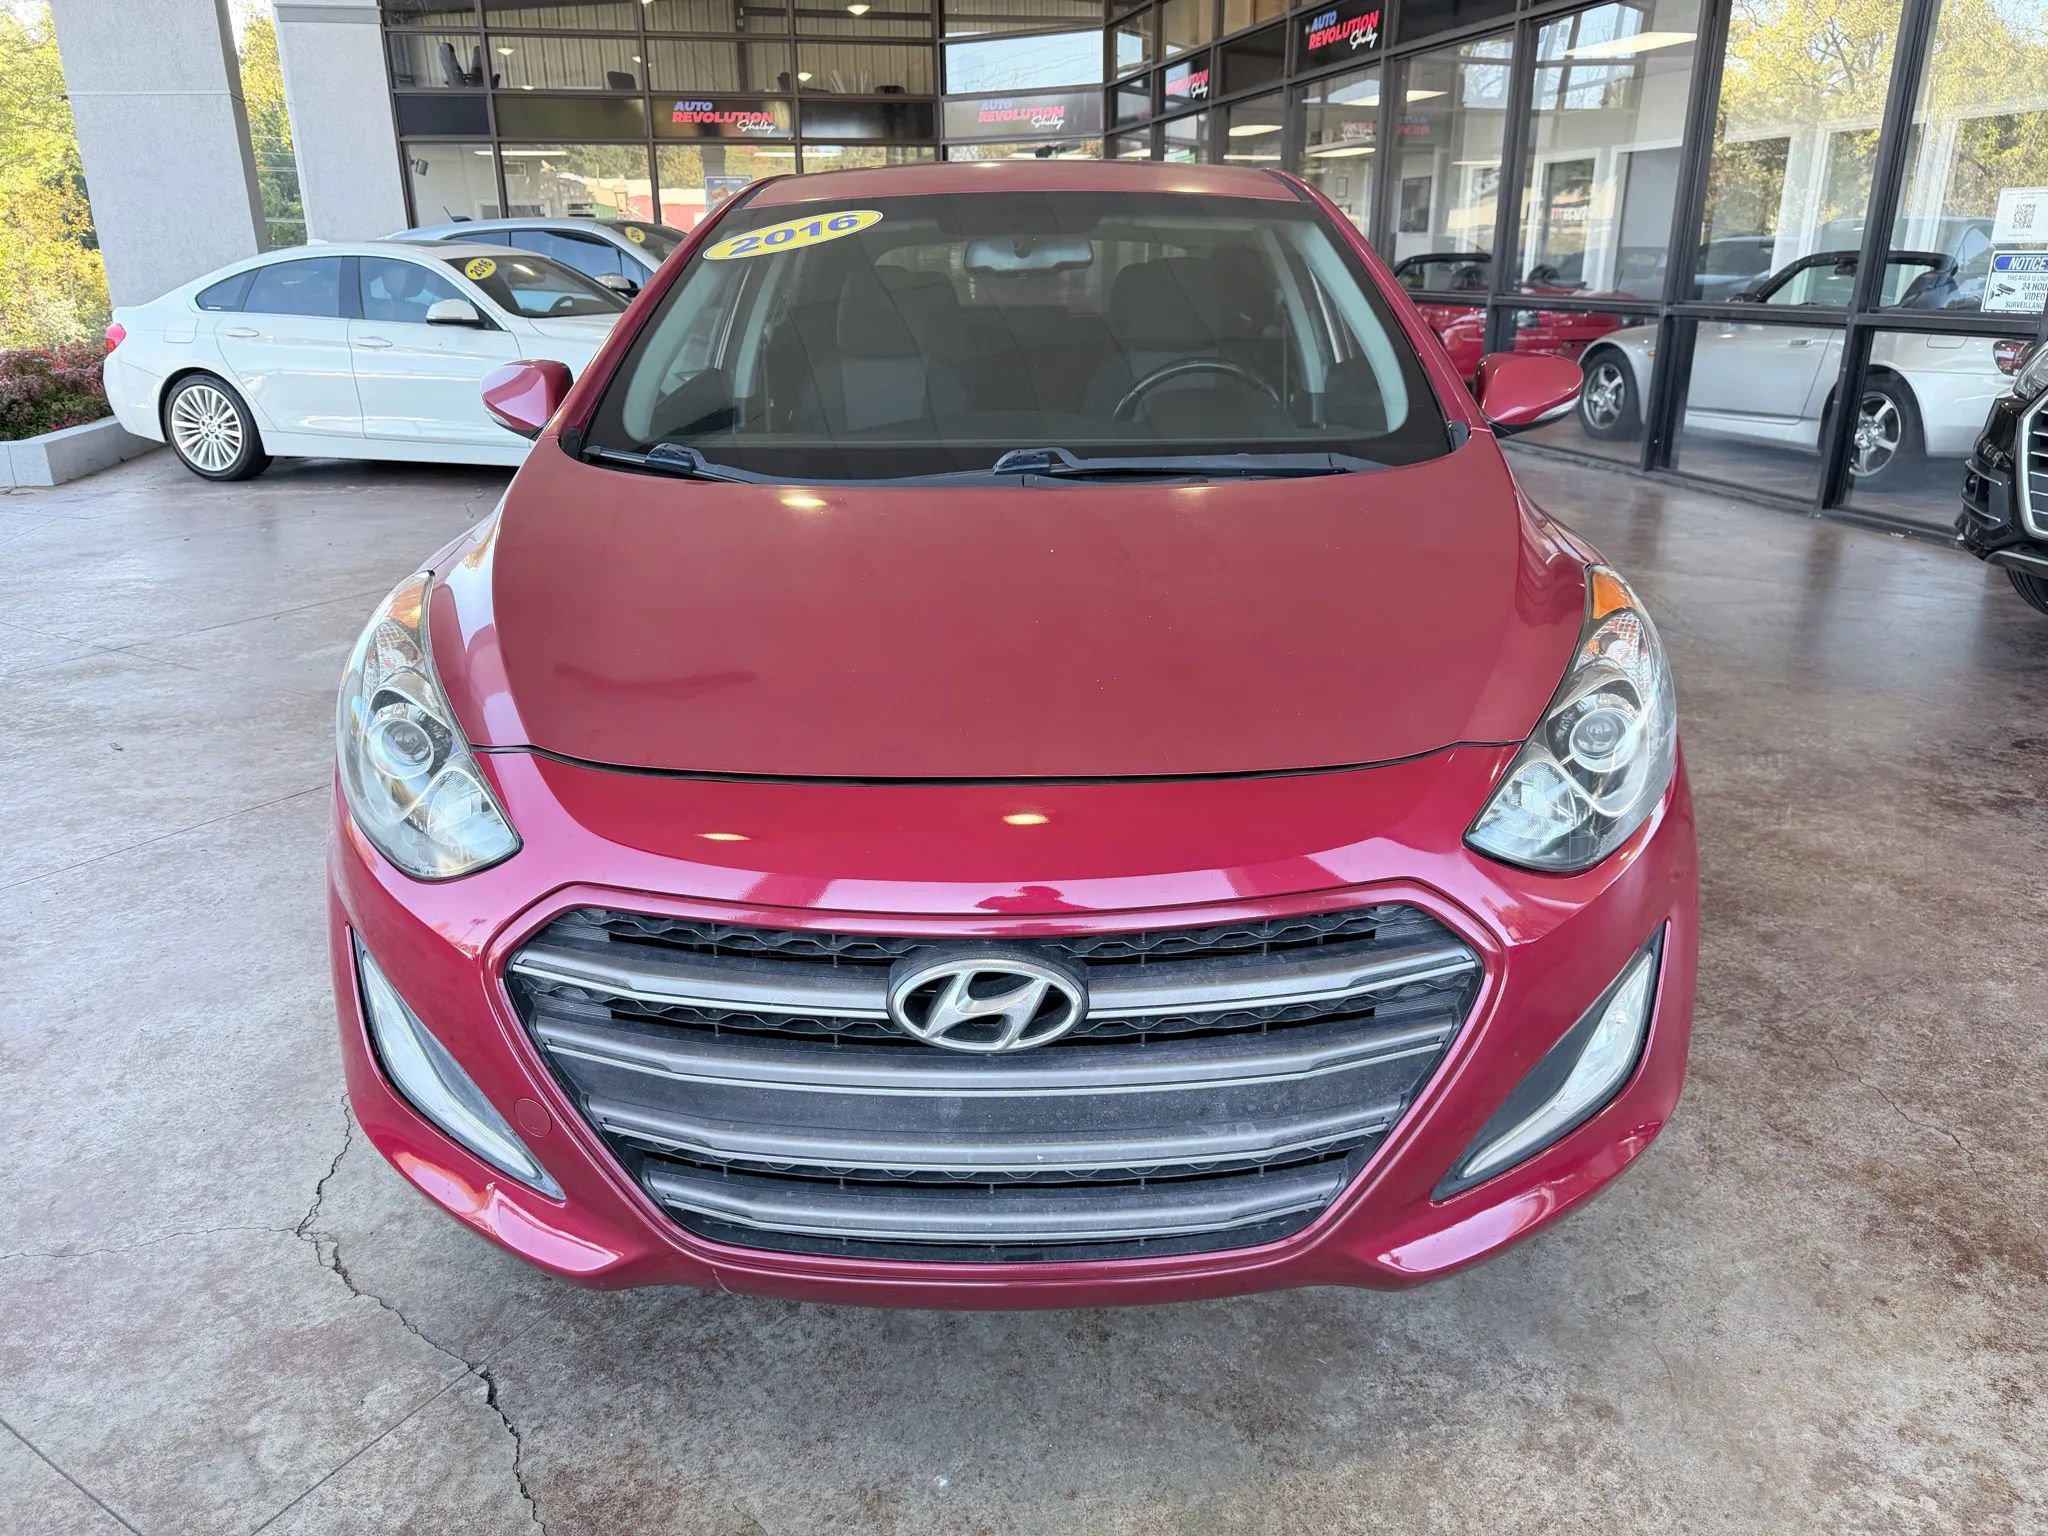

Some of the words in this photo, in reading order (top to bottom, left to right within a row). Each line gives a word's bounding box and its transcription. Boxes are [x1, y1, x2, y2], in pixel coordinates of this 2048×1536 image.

[1311, 10, 1337, 32] AUTO
[1308, 10, 1379, 50] REVOLUTION
[673, 101, 713, 112] AUTO
[981, 99, 1012, 110] AUTO
[672, 111, 775, 123] REVOLUTION
[978, 106, 1065, 123] REVOLUTION
[736, 119, 776, 134] Shelby
[1030, 115, 1065, 130] Shelby
[729, 214, 861, 257] 2016
[470, 259, 493, 278] 2016
[2008, 257, 2048, 270] NOTICE
[2021, 282, 2031, 291] 24
[2024, 292, 2046, 301] VIDEO
